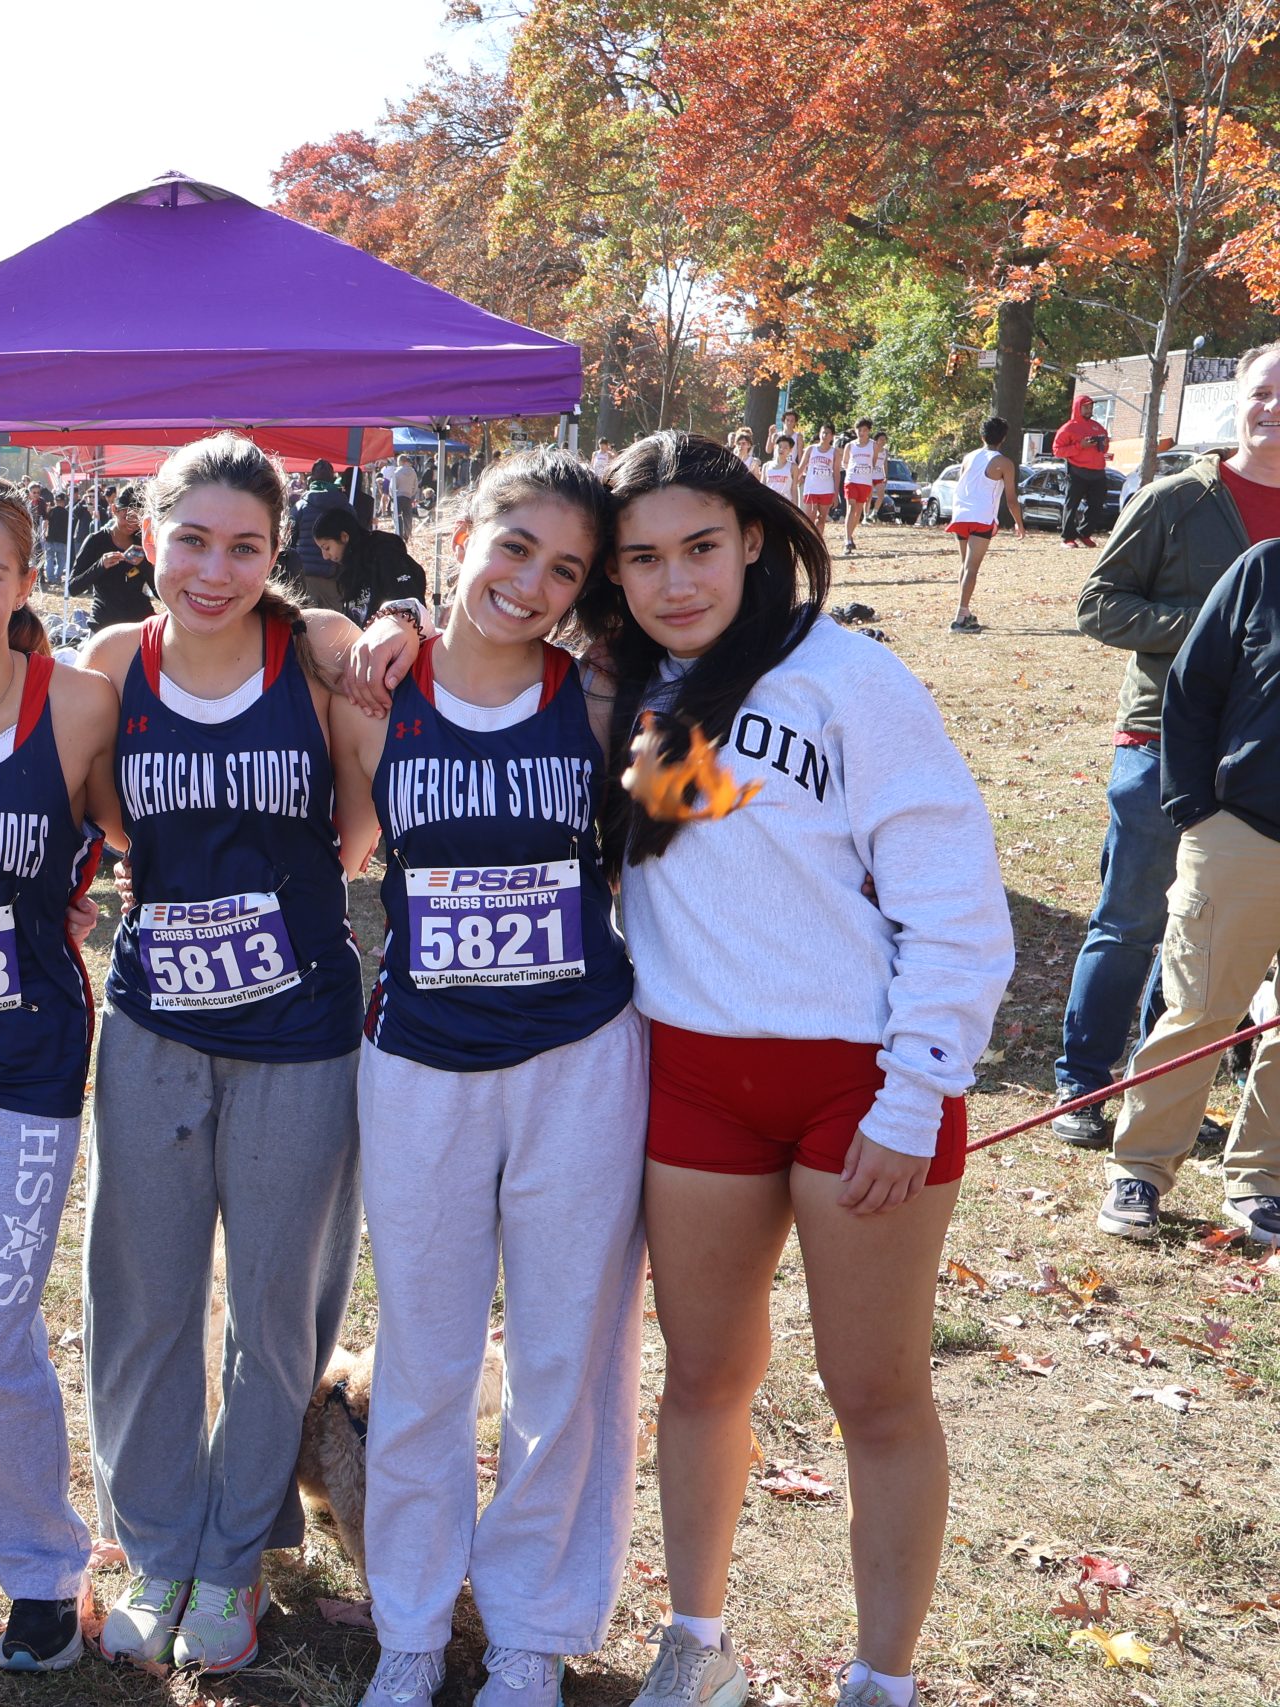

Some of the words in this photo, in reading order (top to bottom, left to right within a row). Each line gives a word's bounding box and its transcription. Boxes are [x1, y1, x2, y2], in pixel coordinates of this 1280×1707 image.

[225, 750, 311, 819] STUDIES
[388, 757, 496, 840] AMERICAN
[506, 756, 592, 833] STUDIES
[152, 928, 194, 941] CROSS
[196, 917, 261, 940] COUNTRY
[429, 896, 481, 910] CROSS
[484, 890, 559, 909] COUNTRY
[148, 932, 284, 994] 5813
[420, 908, 564, 971] 5821
